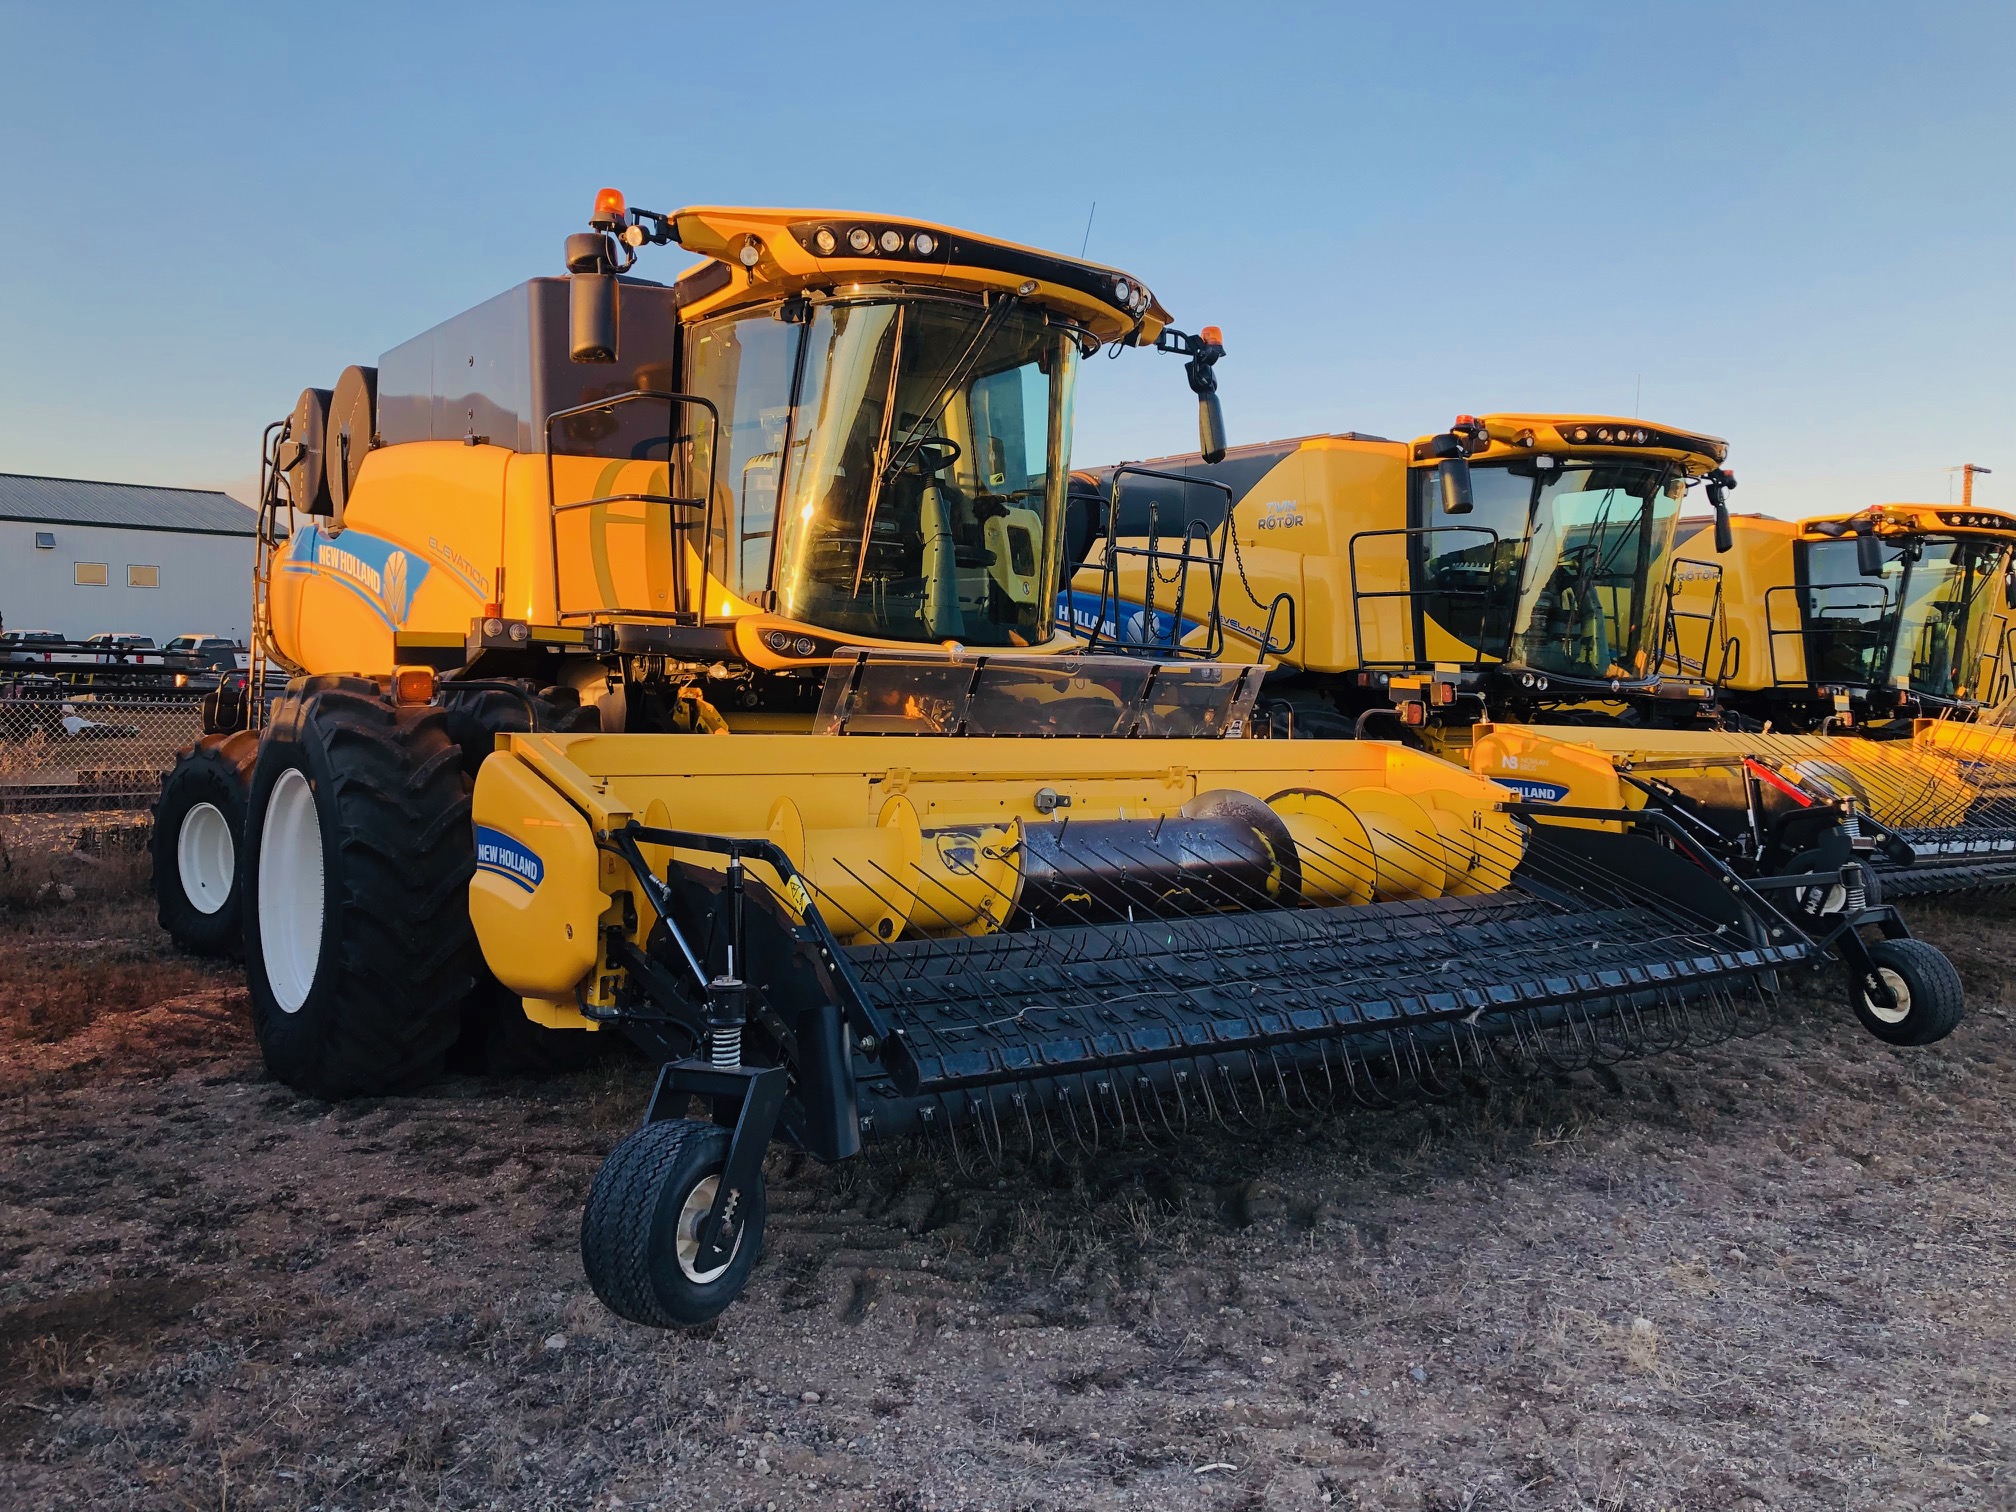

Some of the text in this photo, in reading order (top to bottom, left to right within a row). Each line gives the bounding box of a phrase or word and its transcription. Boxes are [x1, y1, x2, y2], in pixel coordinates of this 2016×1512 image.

[1266, 500, 1297, 513] TWIN
[1258, 512, 1304, 530] ROTOR
[319, 544, 380, 594] NEW HOLLAND
[429, 536, 489, 593] ELEVATION
[1677, 570, 1720, 582] ROTOR
[1510, 786, 1556, 800] LLAND
[478, 843, 538, 881] NEW HOLLAND
